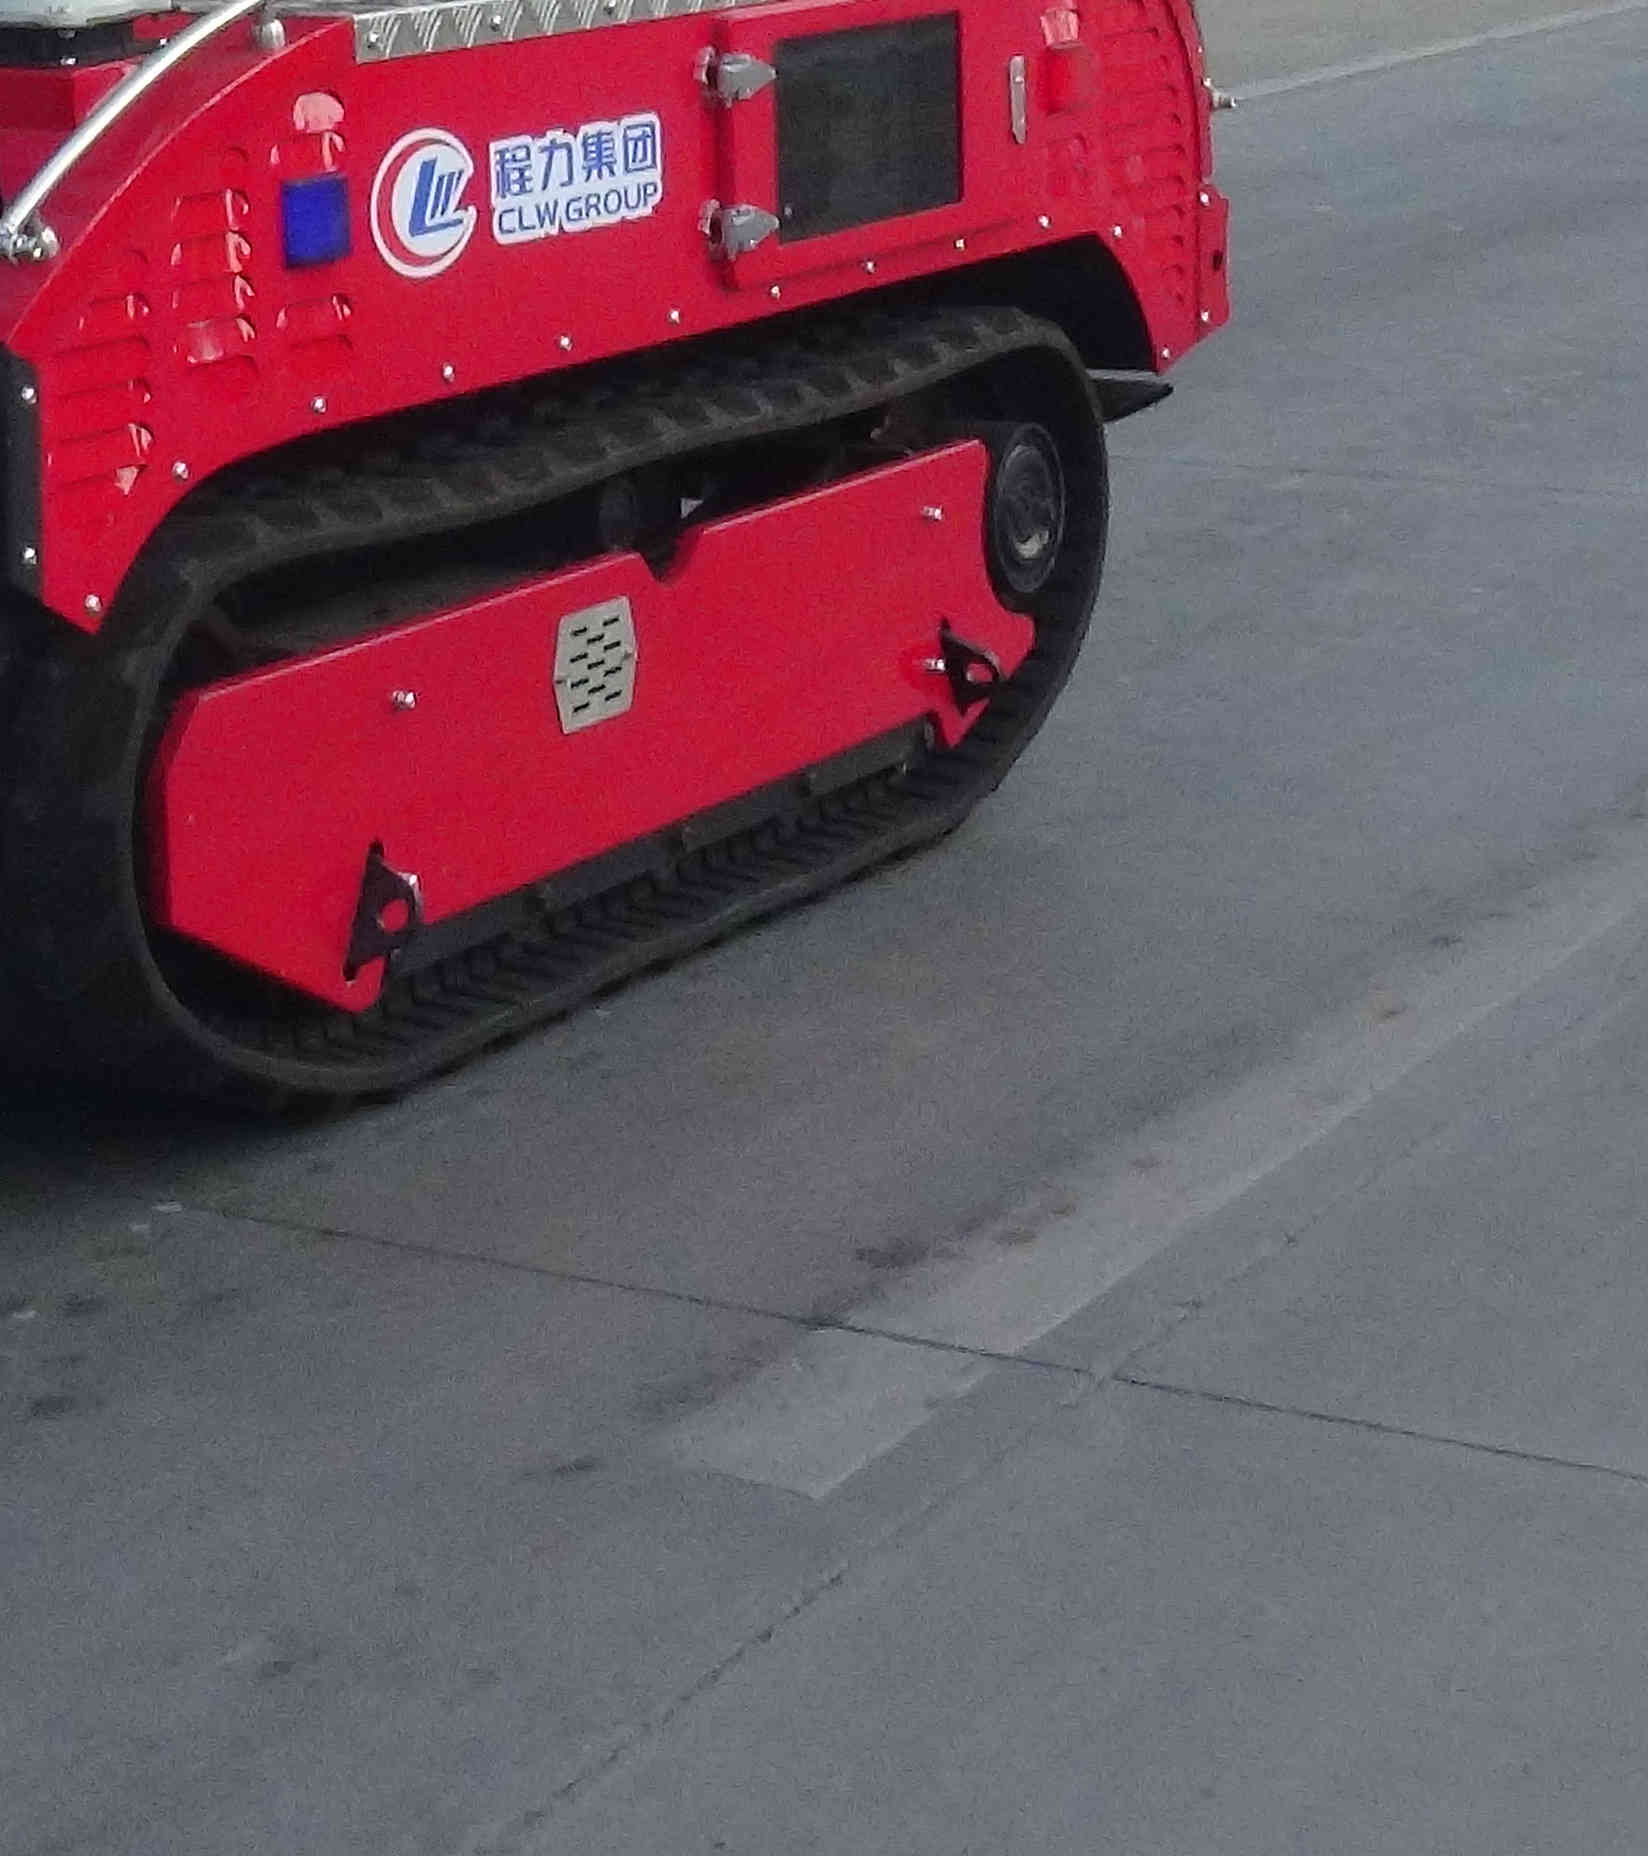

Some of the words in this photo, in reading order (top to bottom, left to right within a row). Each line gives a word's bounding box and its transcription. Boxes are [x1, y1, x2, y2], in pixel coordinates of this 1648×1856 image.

[494, 122, 658, 199] 程力集团
[498, 199, 559, 235] CLW
[565, 181, 658, 223] GROUP
